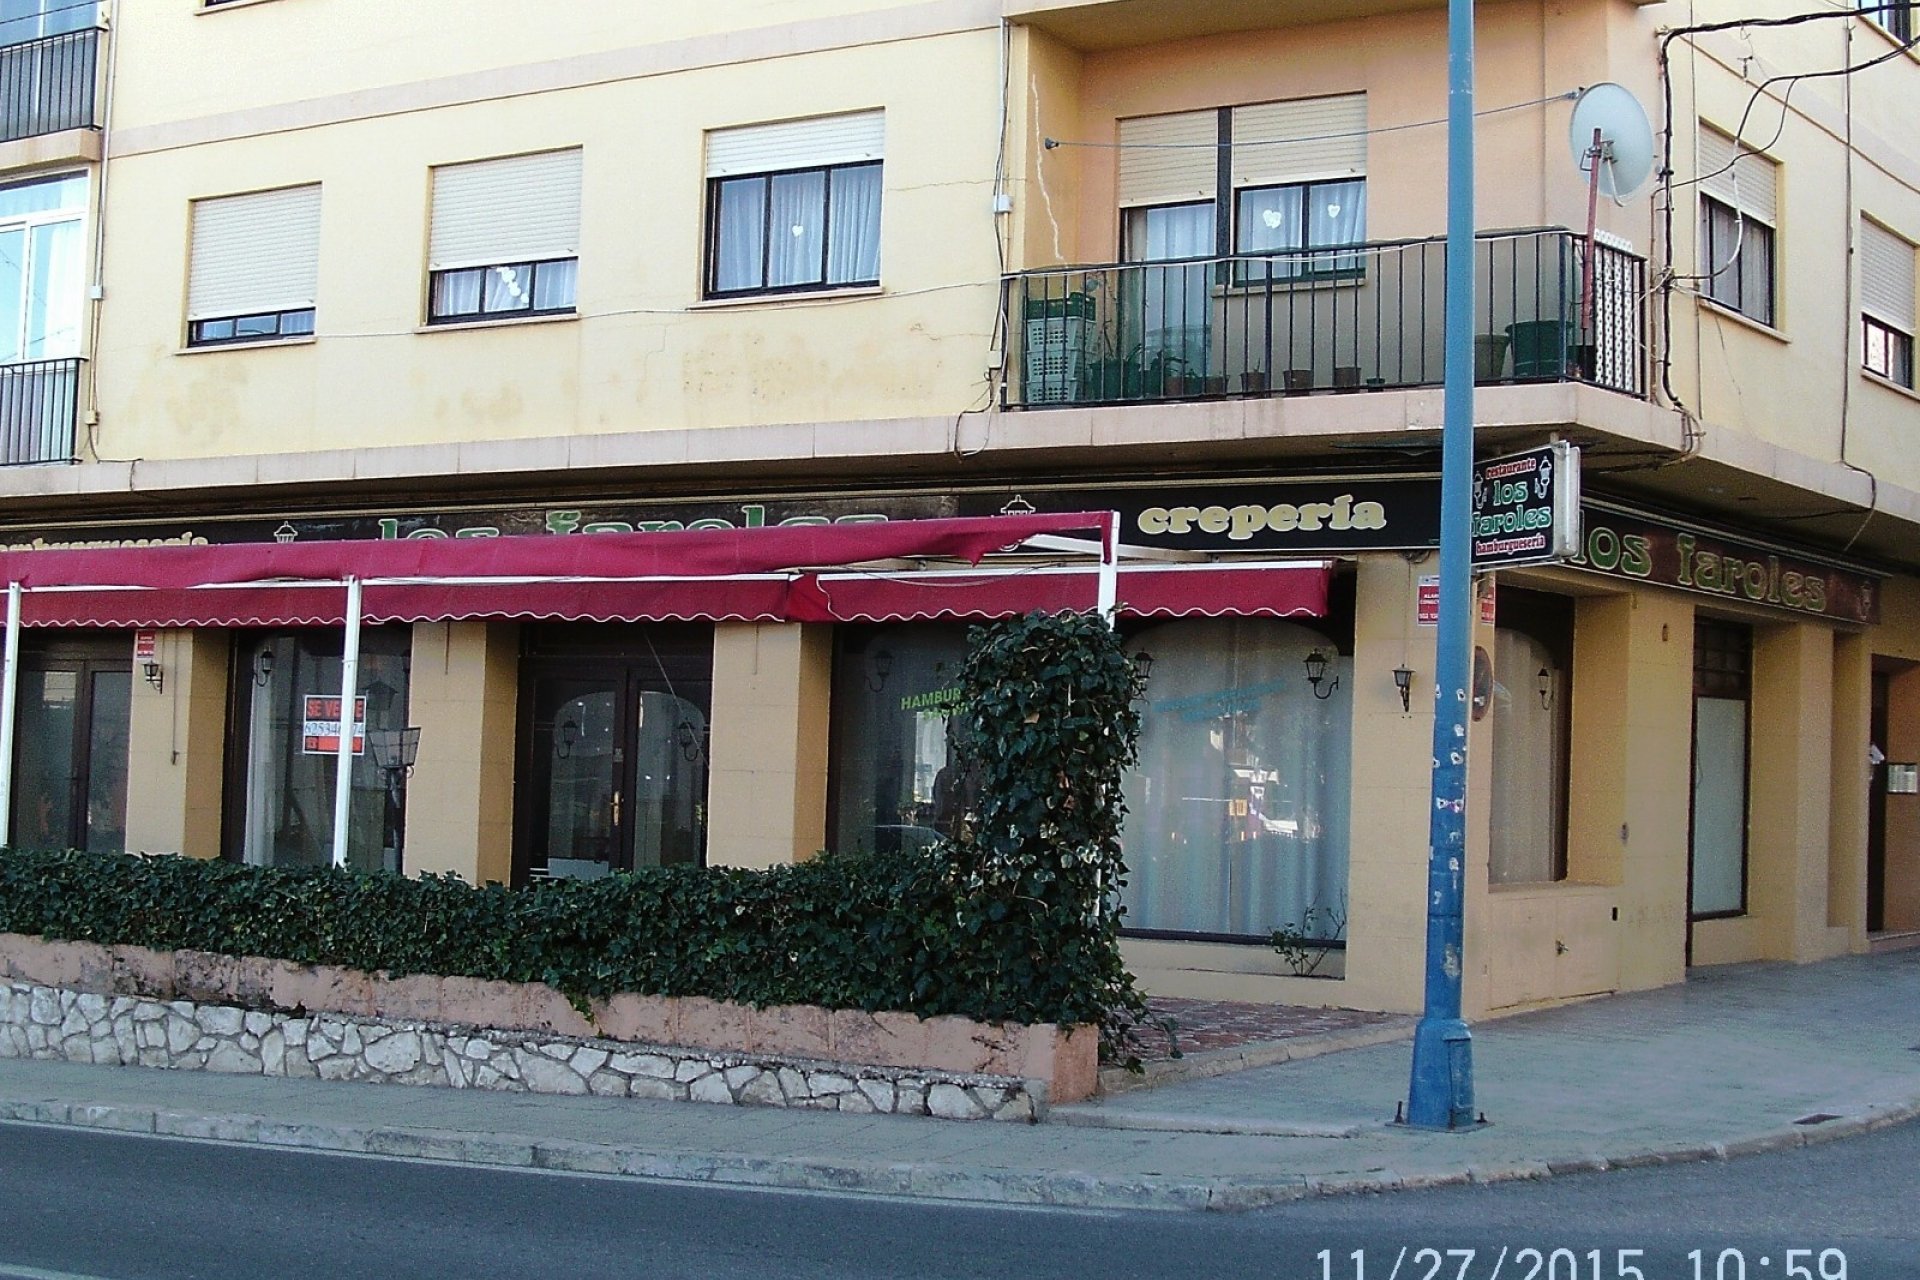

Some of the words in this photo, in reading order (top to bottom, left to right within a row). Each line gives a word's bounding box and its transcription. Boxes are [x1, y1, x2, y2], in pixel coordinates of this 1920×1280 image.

[1486, 458, 1536, 480] restaurante
[1493, 480, 1528, 506] los
[1138, 494, 1387, 540] crepería
[1472, 504, 1552, 537] faroles
[1476, 532, 1546, 556] hamburguesería
[1676, 532, 1826, 611] faroles
[307, 699, 322, 718] SE
[325, 699, 364, 719] VEE
[901, 687, 961, 710] HAMBUR
